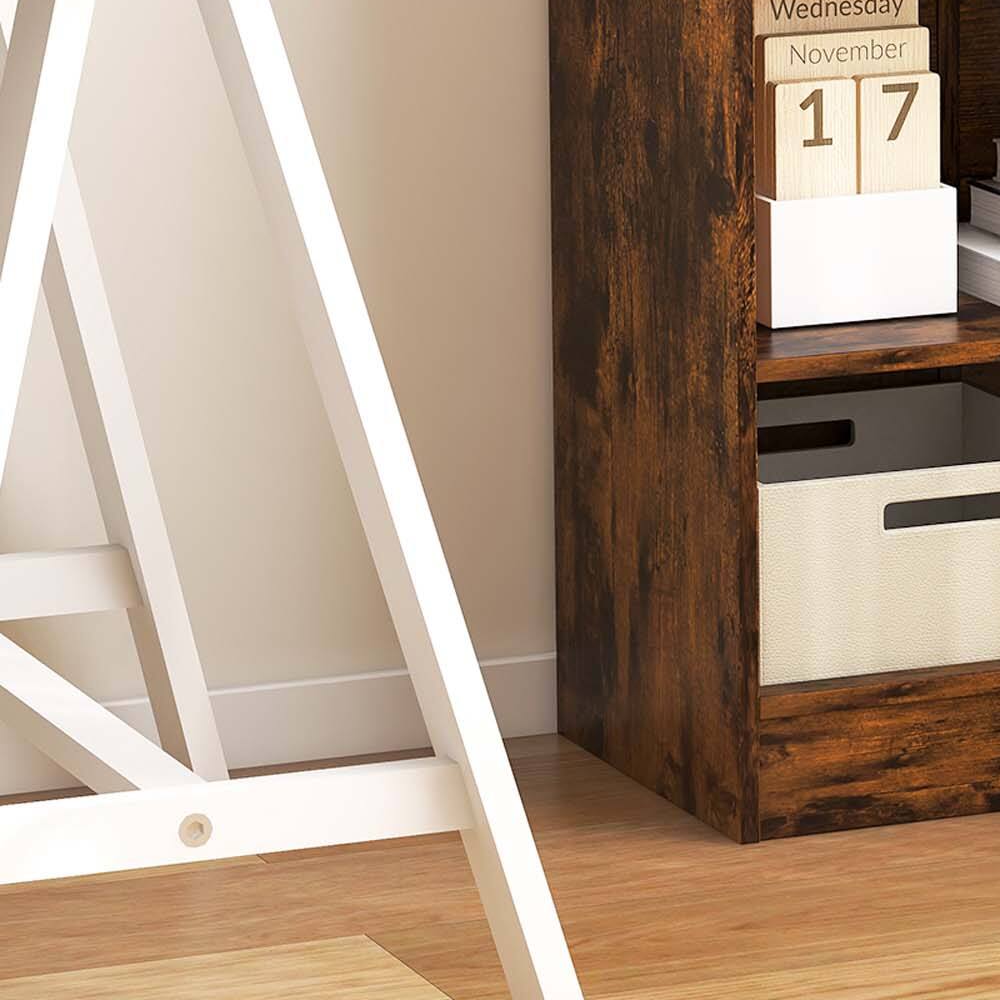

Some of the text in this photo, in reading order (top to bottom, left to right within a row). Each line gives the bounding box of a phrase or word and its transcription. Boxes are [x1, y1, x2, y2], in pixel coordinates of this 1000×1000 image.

[789, 39, 907, 65] November
[799, 81, 920, 148] 1 7
